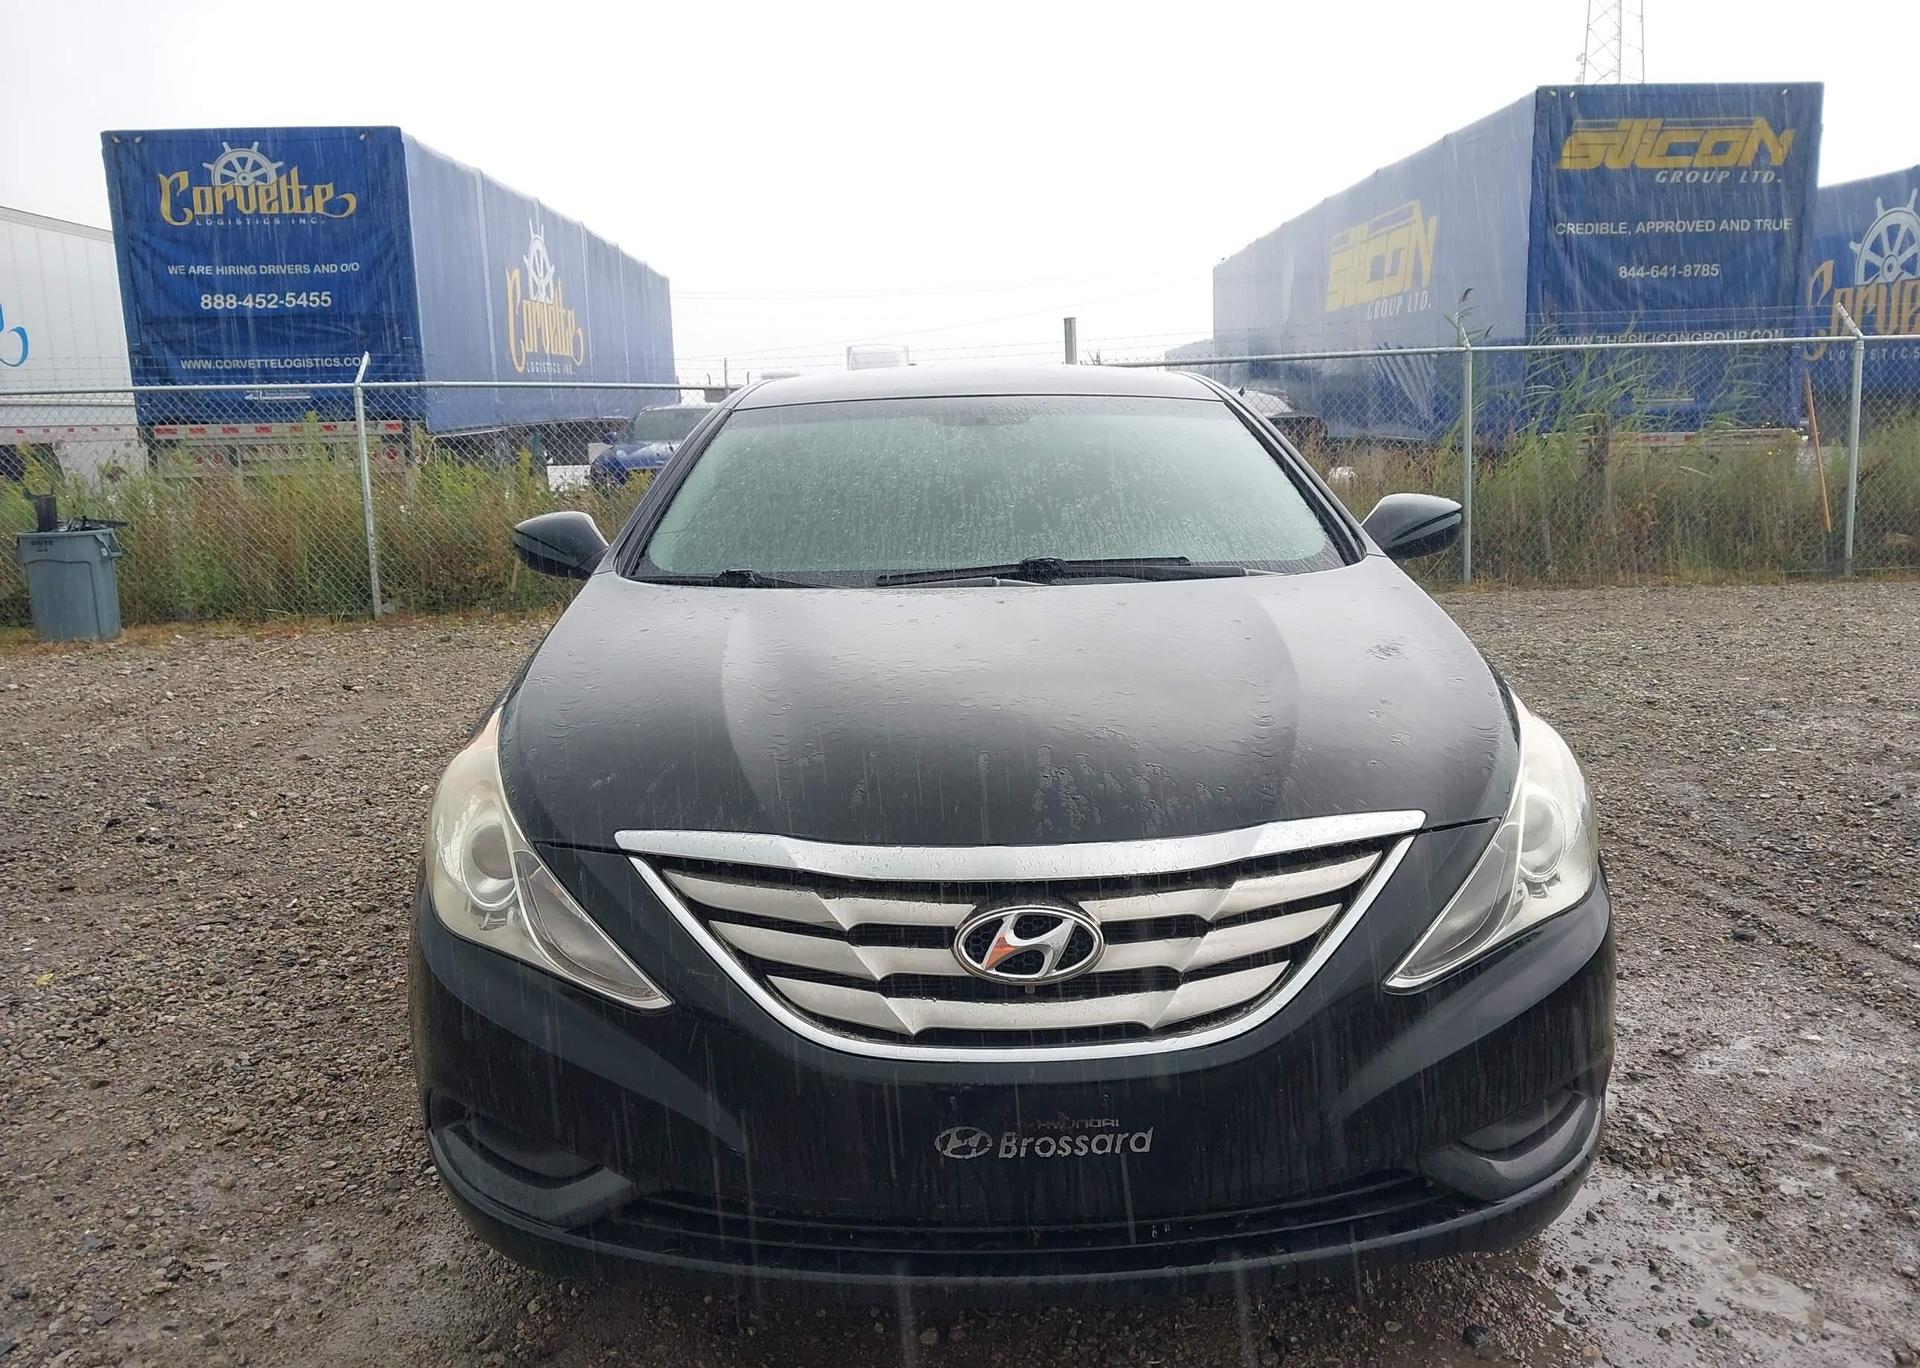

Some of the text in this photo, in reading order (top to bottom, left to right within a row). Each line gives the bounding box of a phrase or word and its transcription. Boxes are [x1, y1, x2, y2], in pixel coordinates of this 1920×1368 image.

[1655, 170, 1782, 183] GROUP LTD.
[158, 166, 358, 226] Corvette
[196, 217, 281, 226] LOGISTICS
[1555, 218, 1793, 236] CREDIBLE, APPROVED AND TRUE
[168, 265, 186, 275] WE
[188, 265, 213, 275] ARE
[216, 264, 257, 275] HIRING
[259, 263, 311, 274] DRIVERS
[313, 262, 338, 273] AND
[1619, 263, 1720, 279] 844-641-8785
[200, 291, 332, 310] 888-452-5455
[1367, 296, 1403, 321] GROUP
[1829, 347, 1920, 361] LOSTICS
[181, 356, 371, 370] WWW.CORVETTELOGISTICS.CO
[998, 1126, 1154, 1159] Brossard
